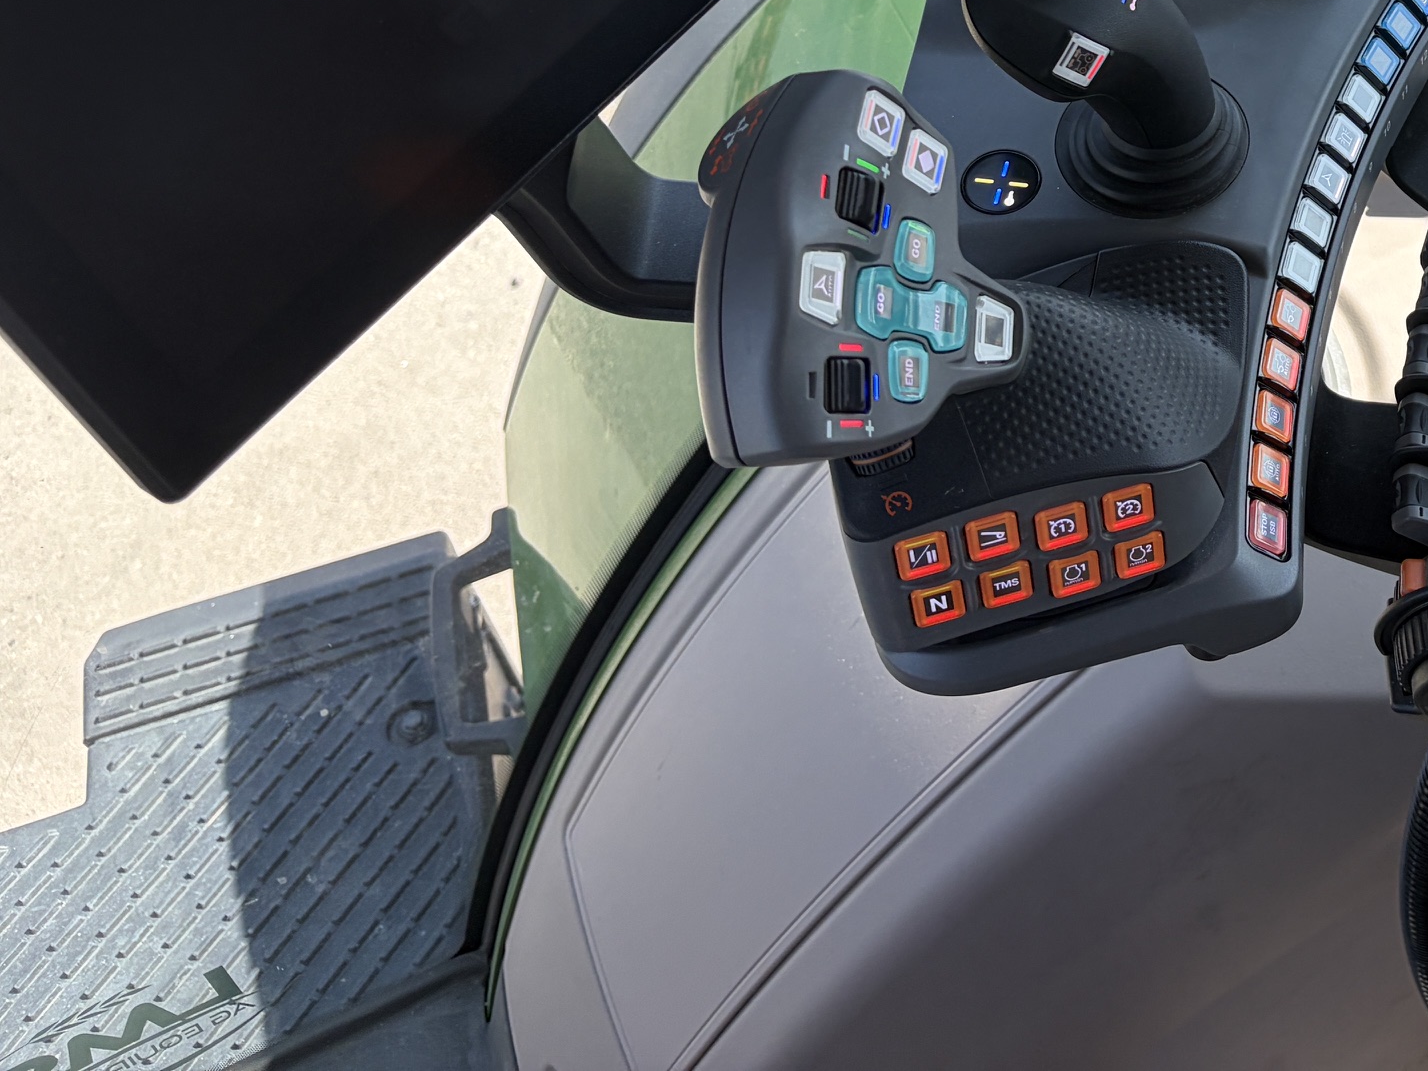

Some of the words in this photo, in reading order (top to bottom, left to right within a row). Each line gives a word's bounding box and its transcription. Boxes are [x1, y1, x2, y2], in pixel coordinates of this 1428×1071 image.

[911, 238, 922, 259] GO
[876, 292, 886, 315] GO
[934, 304, 942, 330] END
[905, 358, 915, 387] END
[1125, 504, 1134, 514] 2
[1260, 513, 1269, 536] STOP
[1145, 544, 1153, 553] 2
[1080, 563, 1087, 572] 1
[993, 577, 1020, 592] TMS
[929, 594, 948, 613] N
